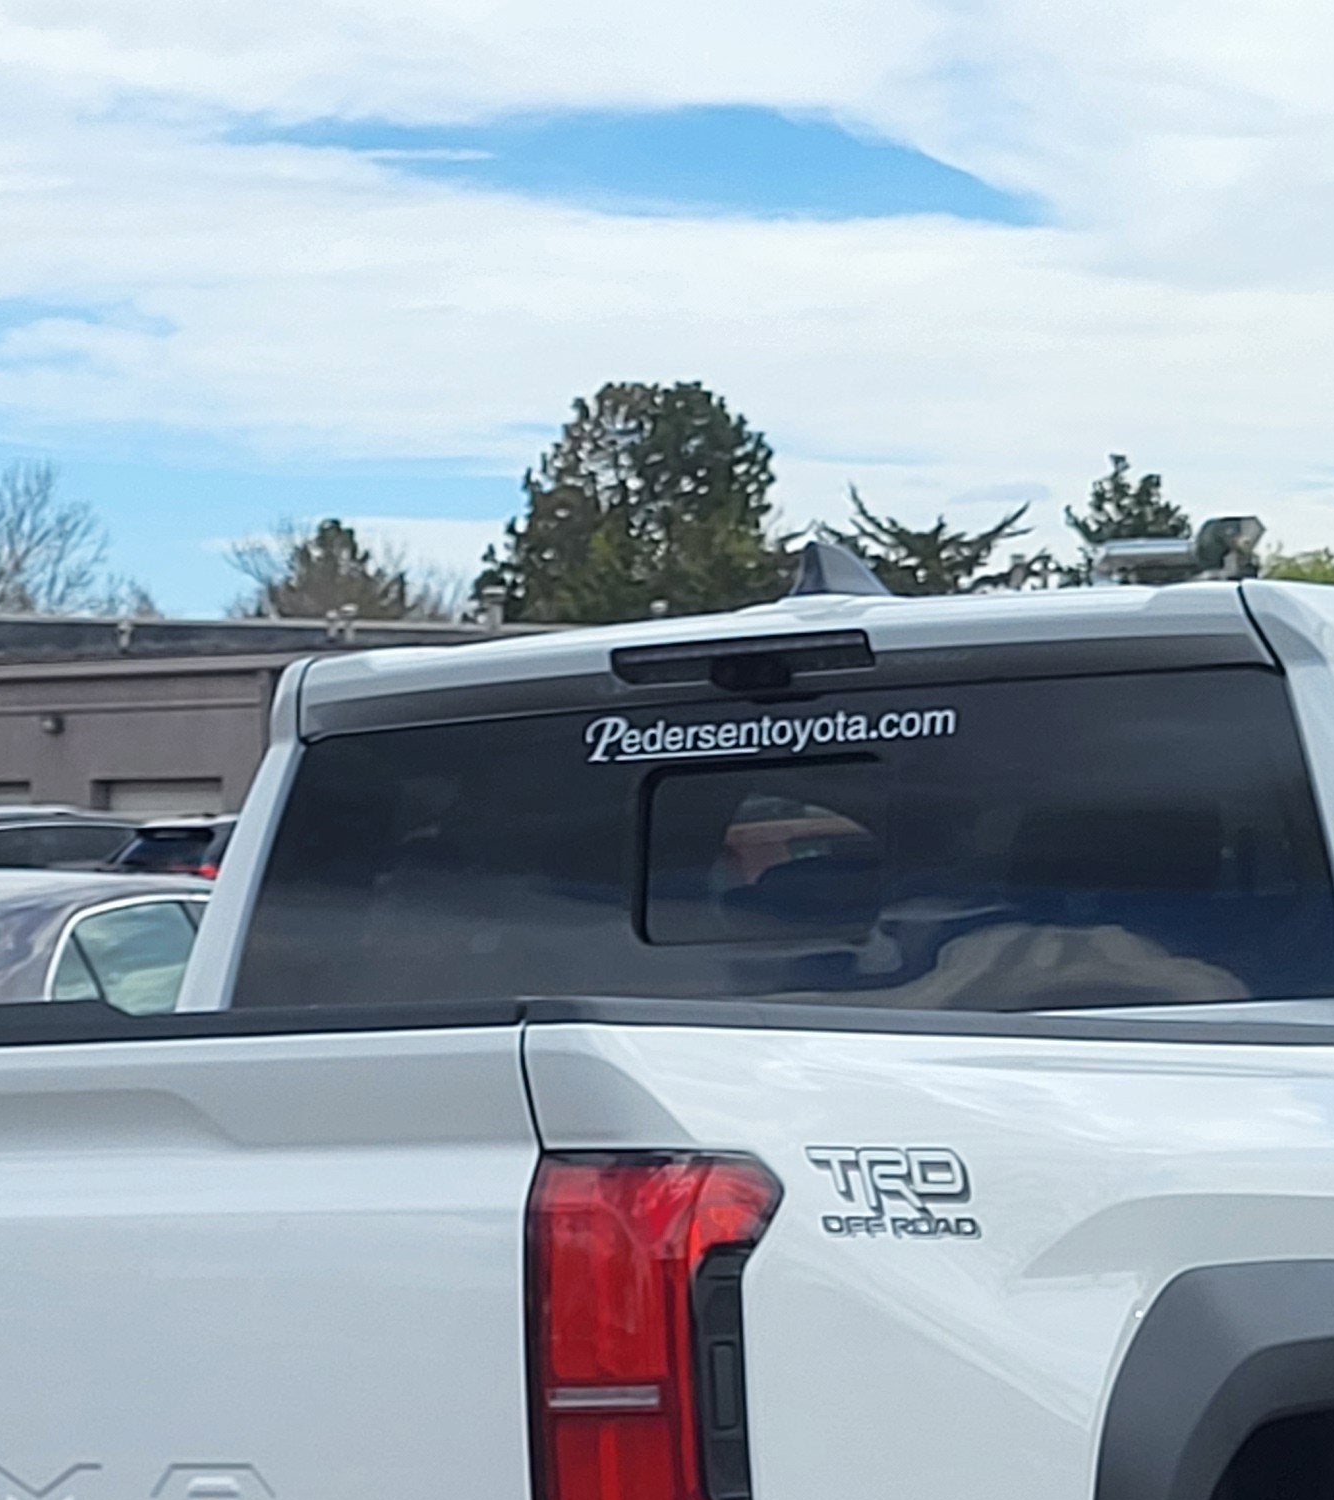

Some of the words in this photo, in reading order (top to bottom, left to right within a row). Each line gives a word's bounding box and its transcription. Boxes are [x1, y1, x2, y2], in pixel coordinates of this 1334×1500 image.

[584, 708, 956, 763] Pedersentoyota.com
[805, 1146, 971, 1217] TRD
[823, 1216, 886, 1238] OFF
[891, 1217, 981, 1239] ROAD
